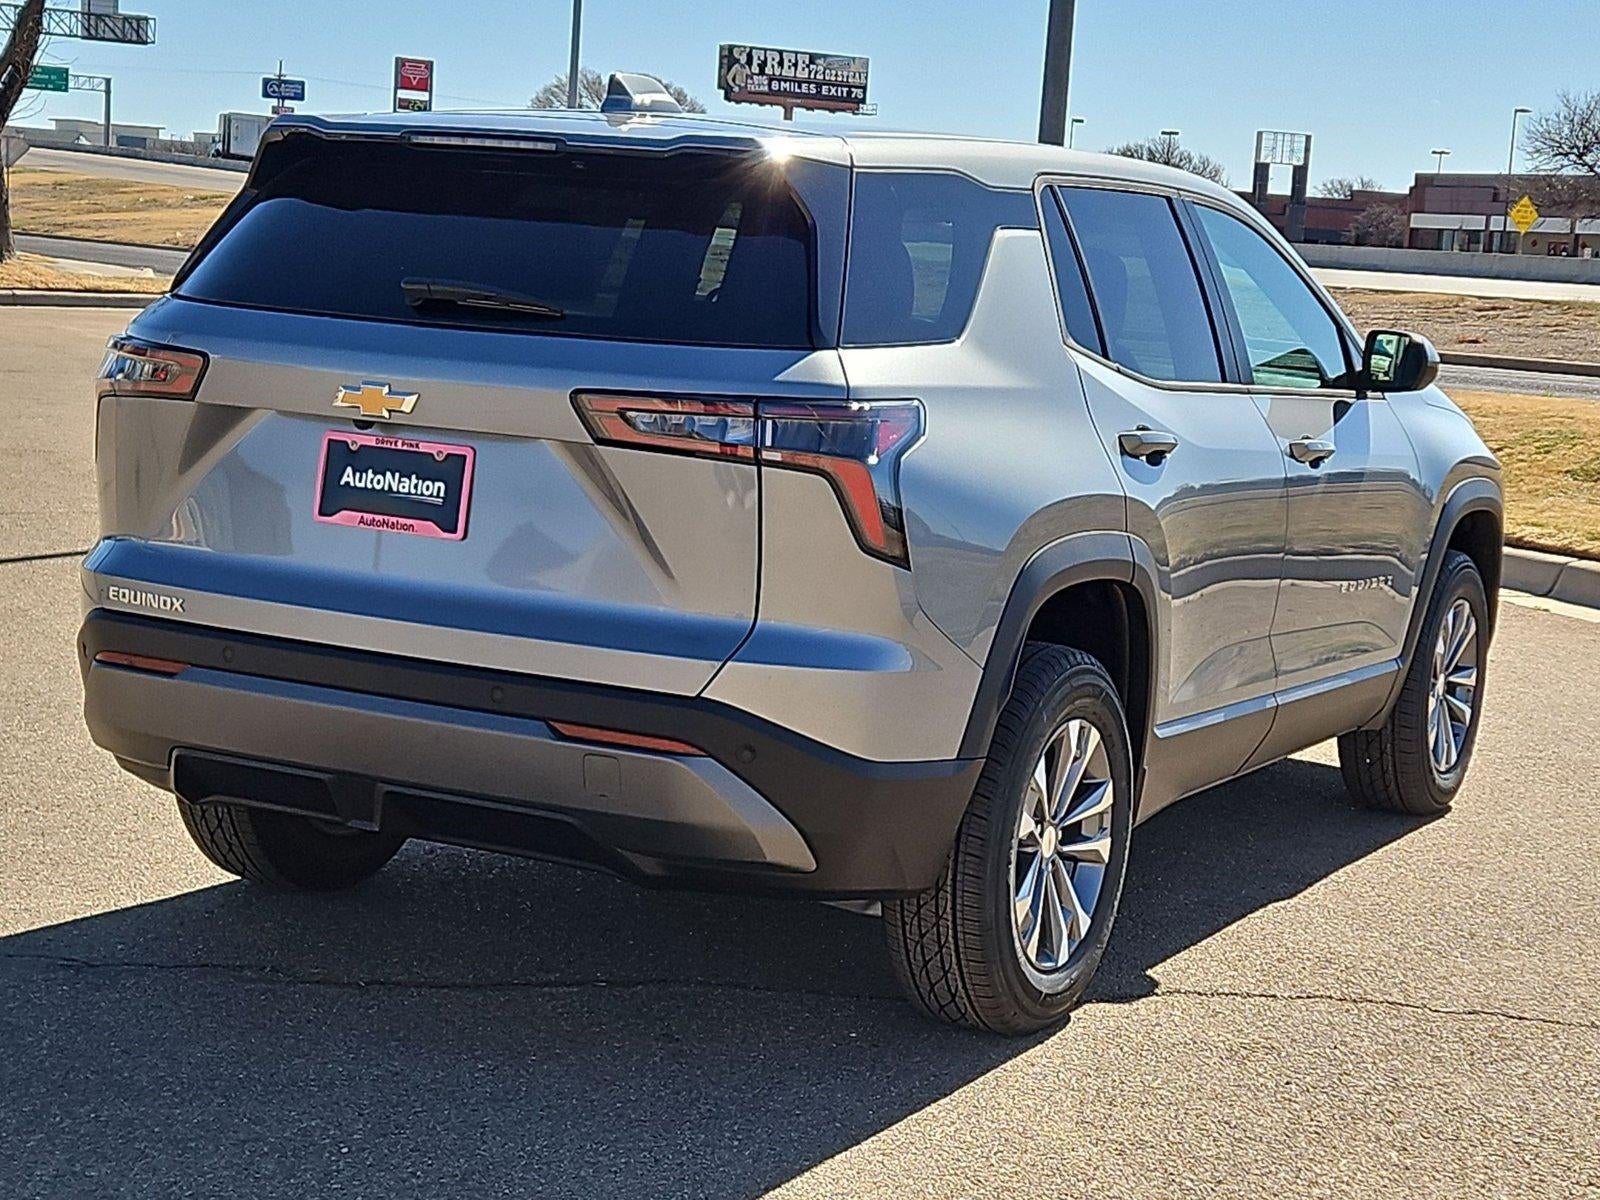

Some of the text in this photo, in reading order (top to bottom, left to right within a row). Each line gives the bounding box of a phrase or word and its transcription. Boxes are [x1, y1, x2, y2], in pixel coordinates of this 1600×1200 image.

[751, 49, 810, 79] FREE
[809, 64, 825, 80] 72
[780, 81, 817, 94] MILES
[821, 85, 849, 97] EXIT
[851, 88, 864, 99] 75
[375, 437, 421, 450] DRIVE PINK
[340, 465, 446, 498] AutoNation
[108, 586, 185, 613] EQUINOX
